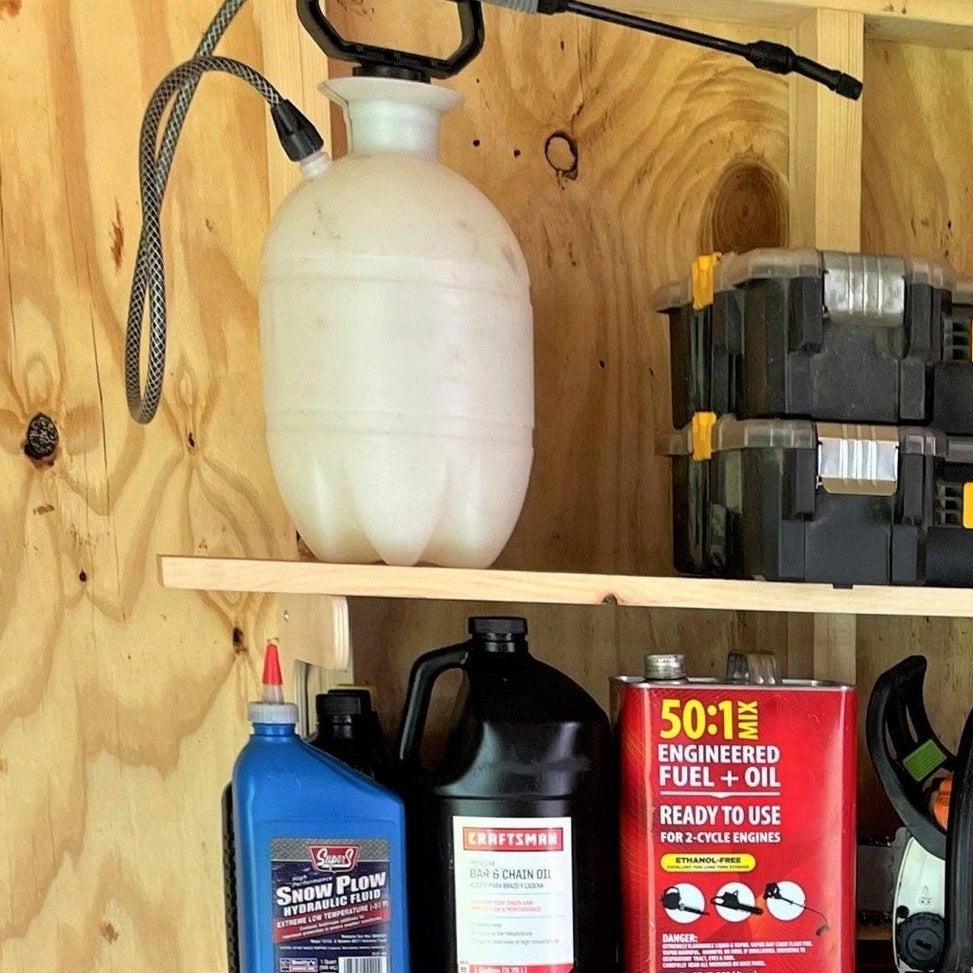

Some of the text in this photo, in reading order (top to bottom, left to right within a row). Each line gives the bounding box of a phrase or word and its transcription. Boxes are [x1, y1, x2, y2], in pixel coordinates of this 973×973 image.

[659, 698, 759, 741] 50:1 MIX
[658, 744, 781, 764] ENGINEERED
[658, 766, 782, 788] FUEL + OIL
[660, 804, 782, 826] READY TO USE
[468, 832, 558, 846] CRAFTSMAN
[660, 831, 782, 844] FOR 2-CYCLE ENGINES
[675, 856, 742, 864] ETHANOL-FREE
[470, 869, 552, 880] BAR & CHAIN OIL
[283, 888, 381, 917] HYDRAULIC FLUID
[276, 918, 307, 928] EXTREME
[308, 914, 323, 923] LOW
[324, 904, 369, 920] TEMPERATURE
[662, 934, 698, 943] DANGER:
